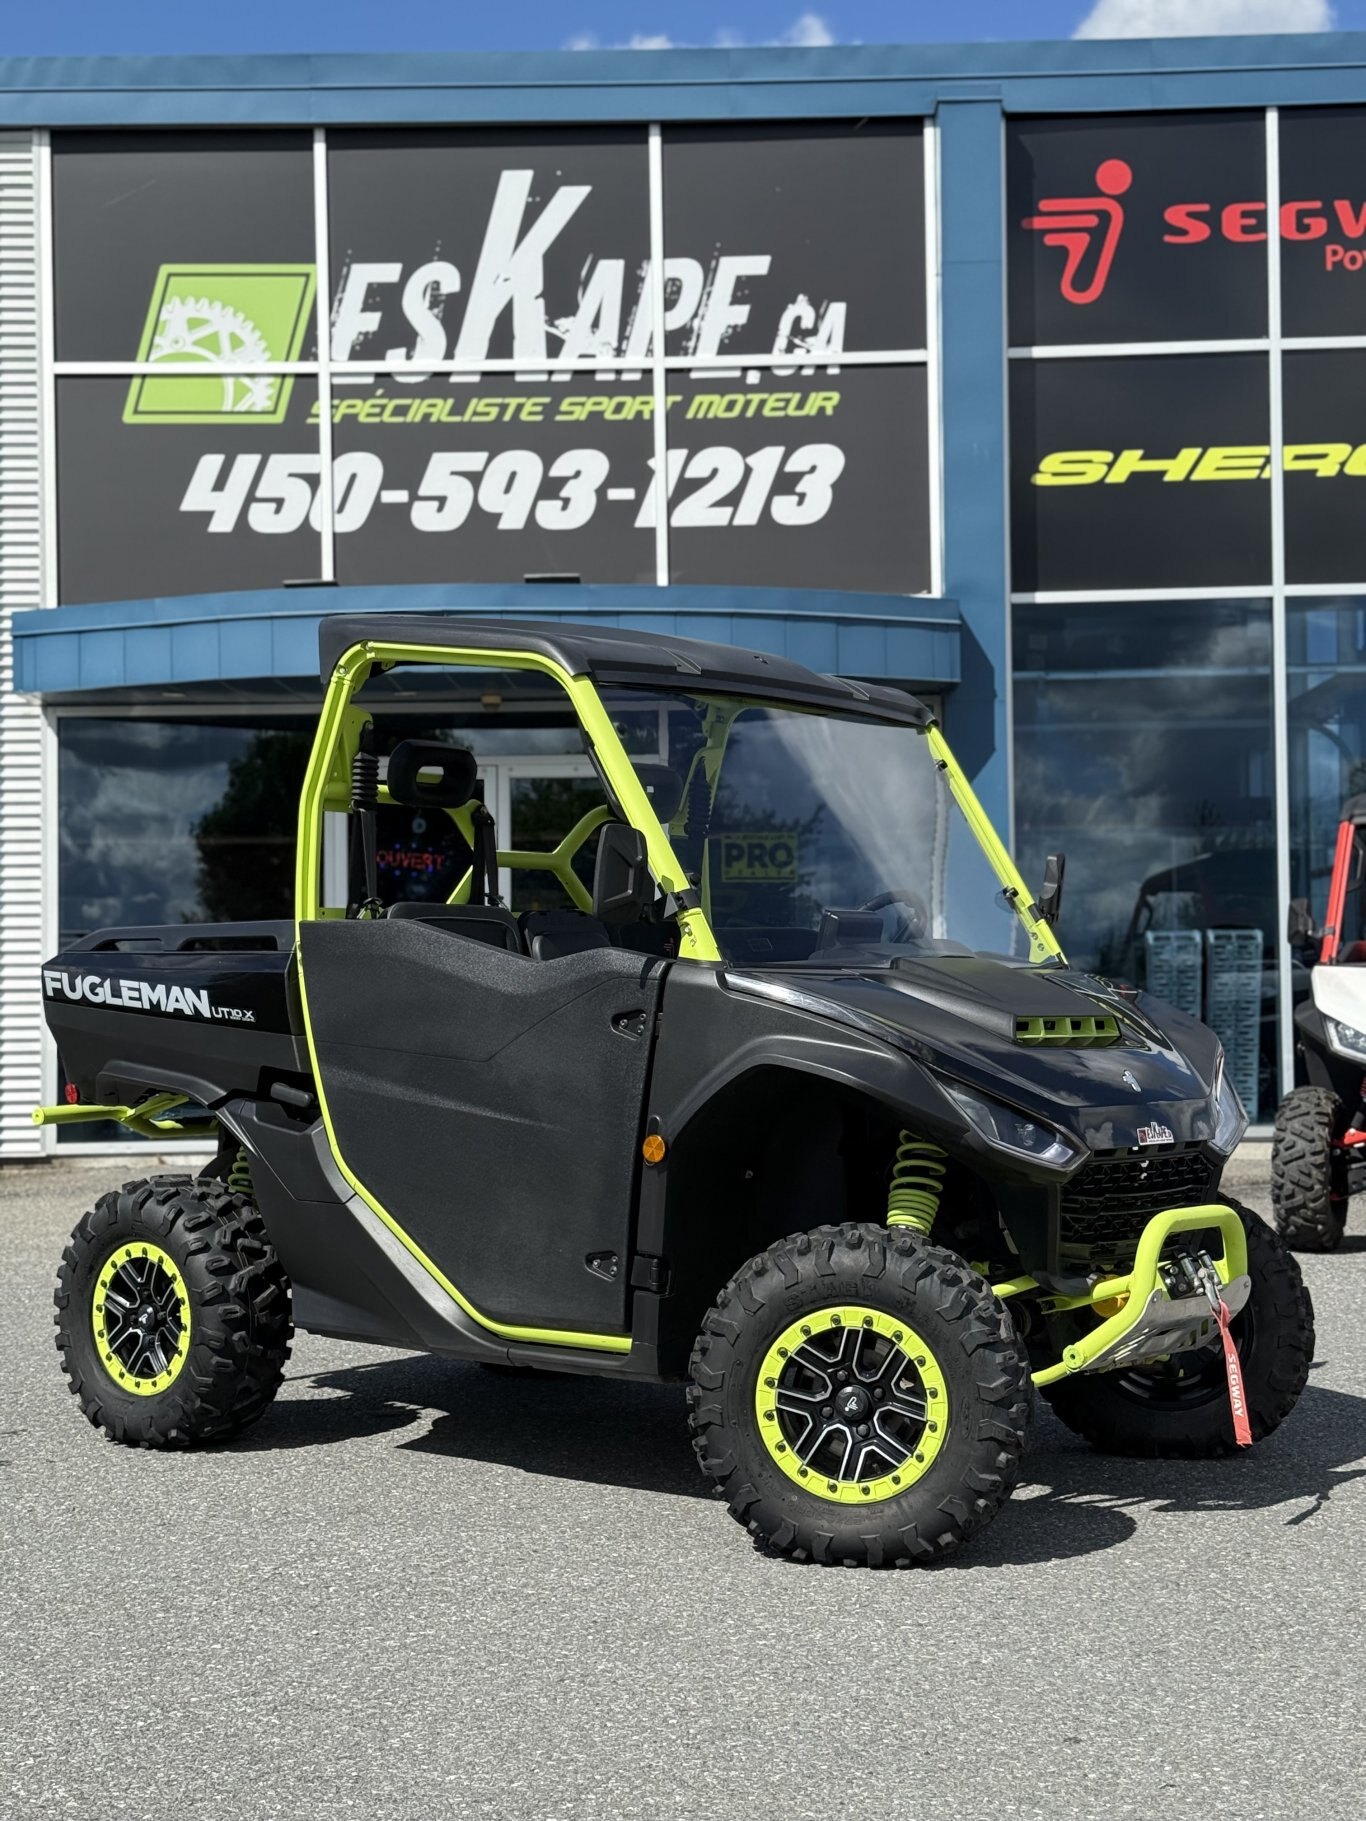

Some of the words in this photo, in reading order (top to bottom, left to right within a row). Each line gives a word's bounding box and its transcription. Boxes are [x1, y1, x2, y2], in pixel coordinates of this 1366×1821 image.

[1325, 244, 1366, 271] Po
[686, 391, 840, 420] MOTEUR
[1031, 443, 1366, 486] SHER
[179, 443, 846, 534] 450-593-1213
[725, 842, 794, 869] PRO
[43, 970, 211, 1018] FUGLEMAN
[1228, 1353, 1244, 1417] SEGWAY
